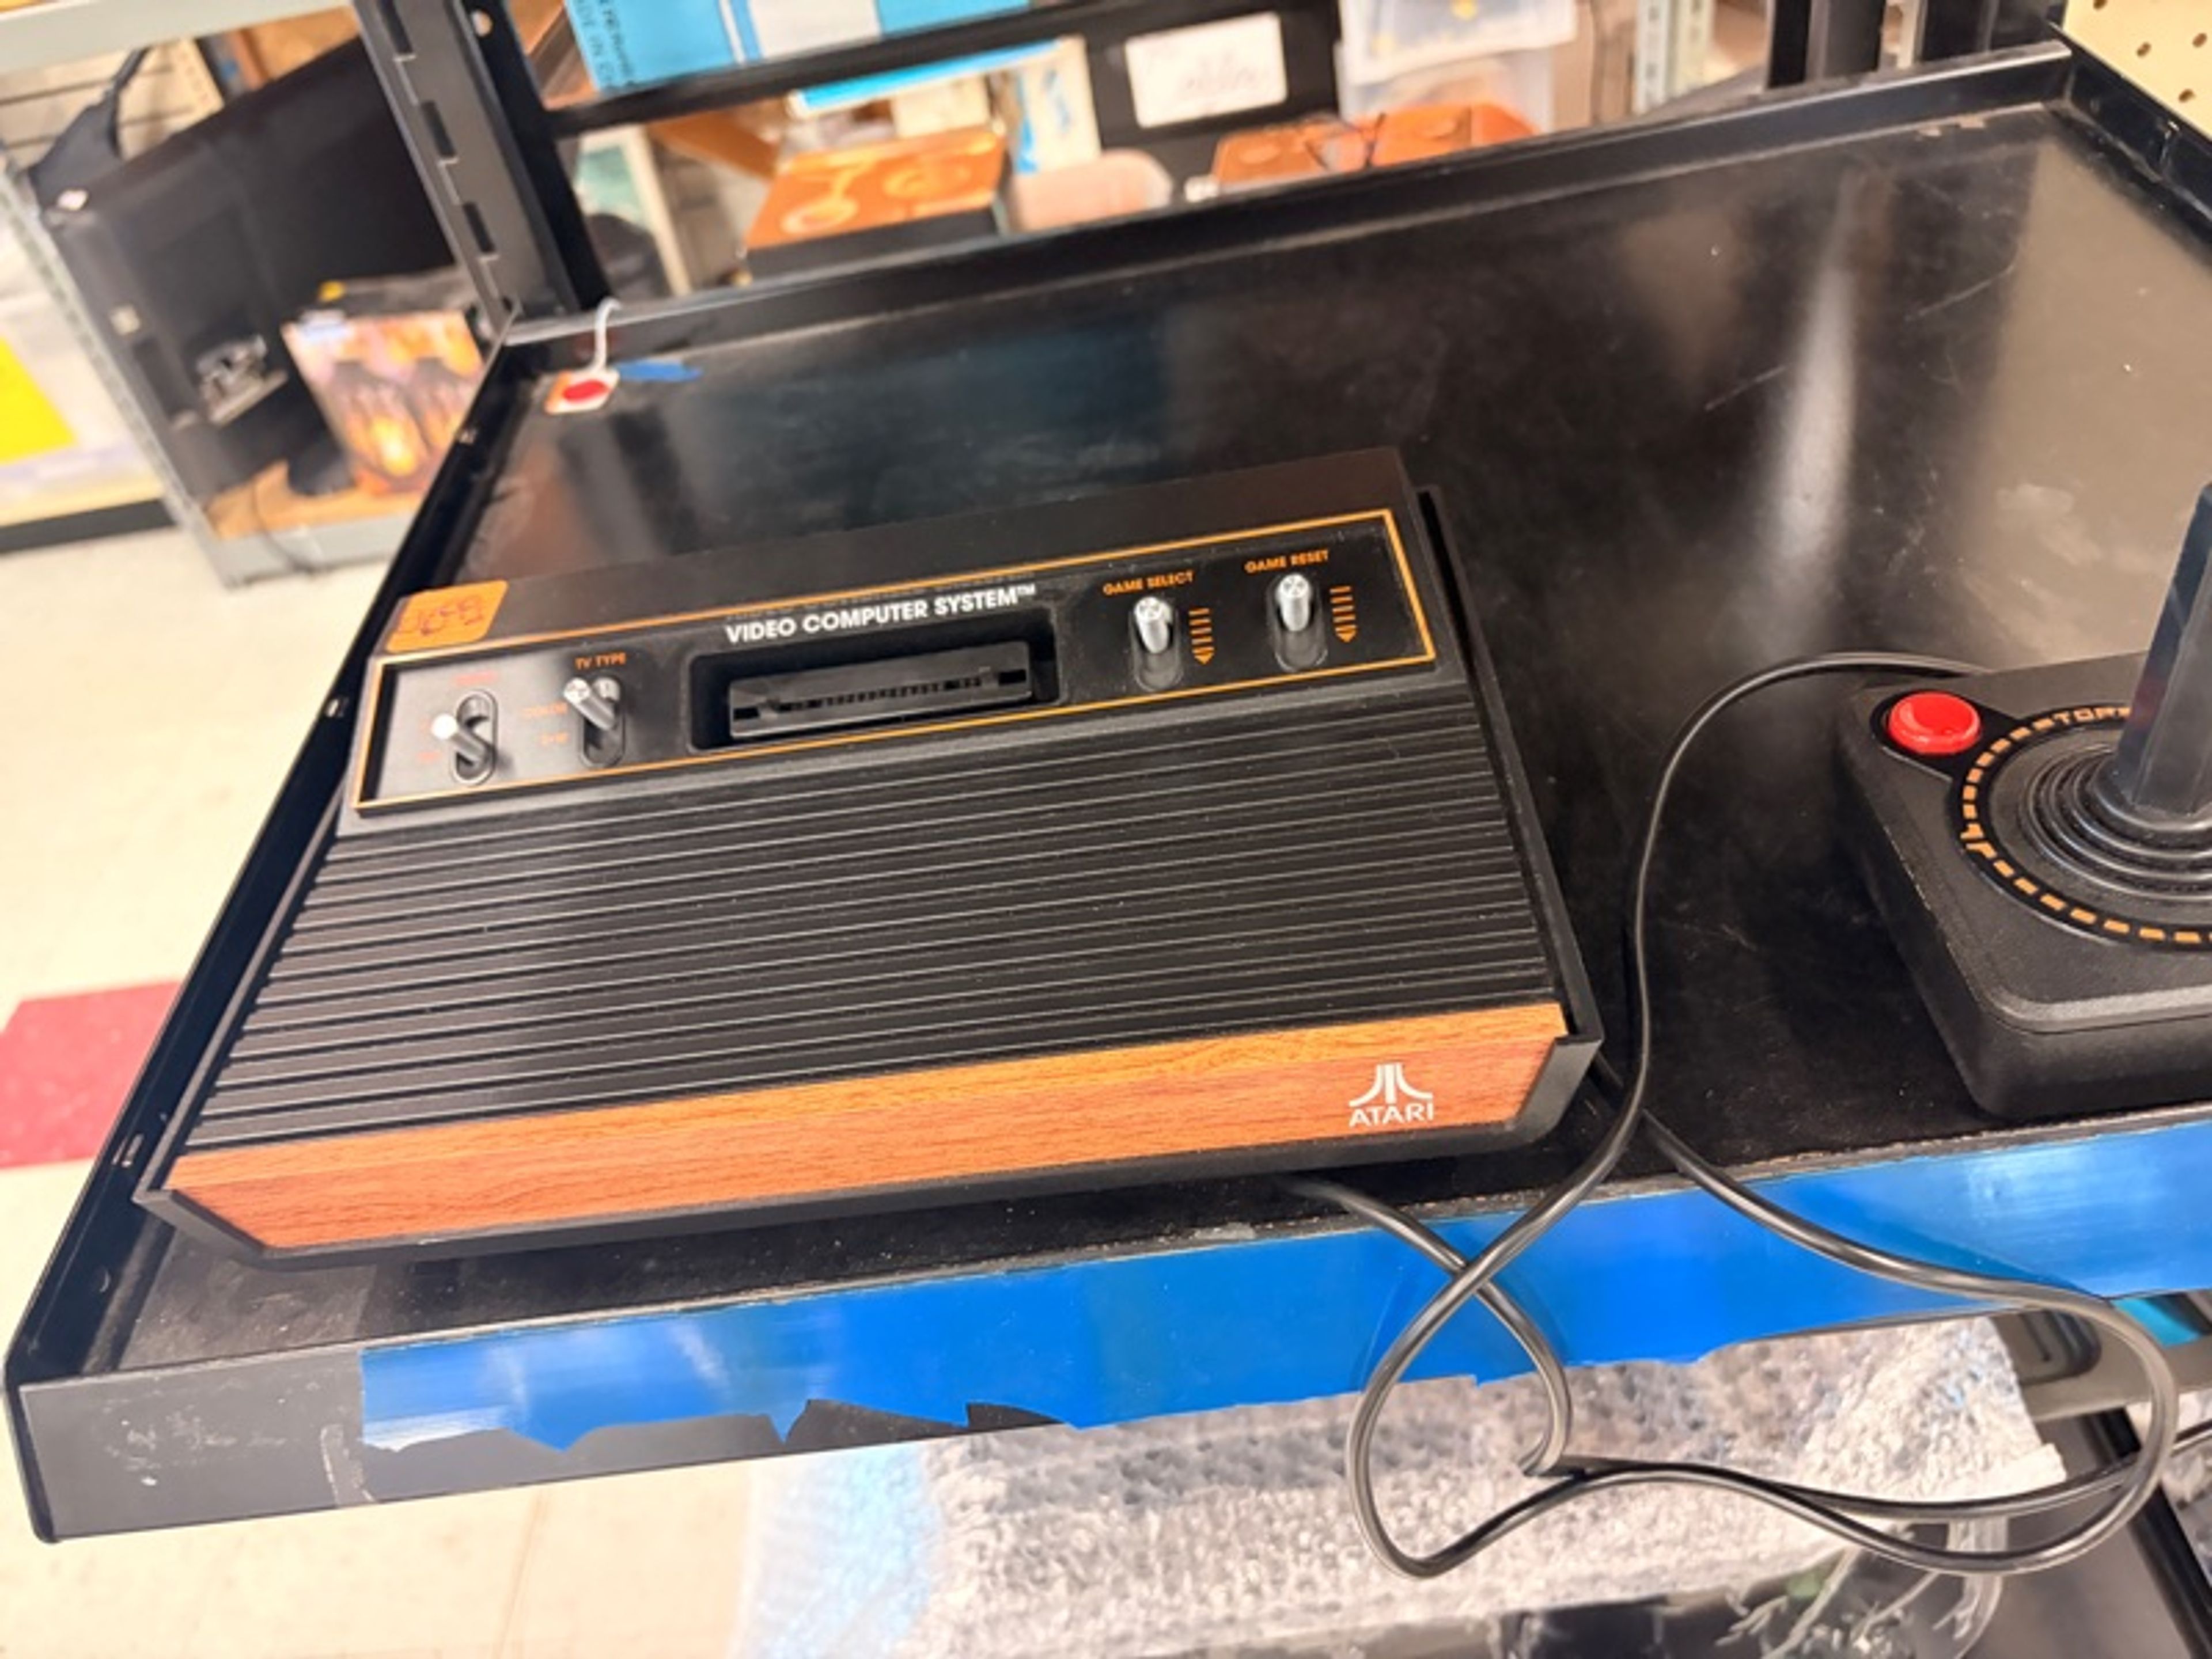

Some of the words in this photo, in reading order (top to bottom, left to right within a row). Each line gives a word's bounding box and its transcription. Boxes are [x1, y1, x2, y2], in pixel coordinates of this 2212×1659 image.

[1245, 556, 1287, 573] GAME
[1291, 550, 1329, 565] RESET
[1103, 578, 1143, 596] GAME
[1147, 570, 1194, 588] SELECT
[724, 618, 797, 643] VIDEO
[802, 599, 928, 633] COMPUTER
[575, 657, 592, 670] TV
[596, 652, 626, 668] TYPE
[1348, 1103, 1434, 1127] ATARI
